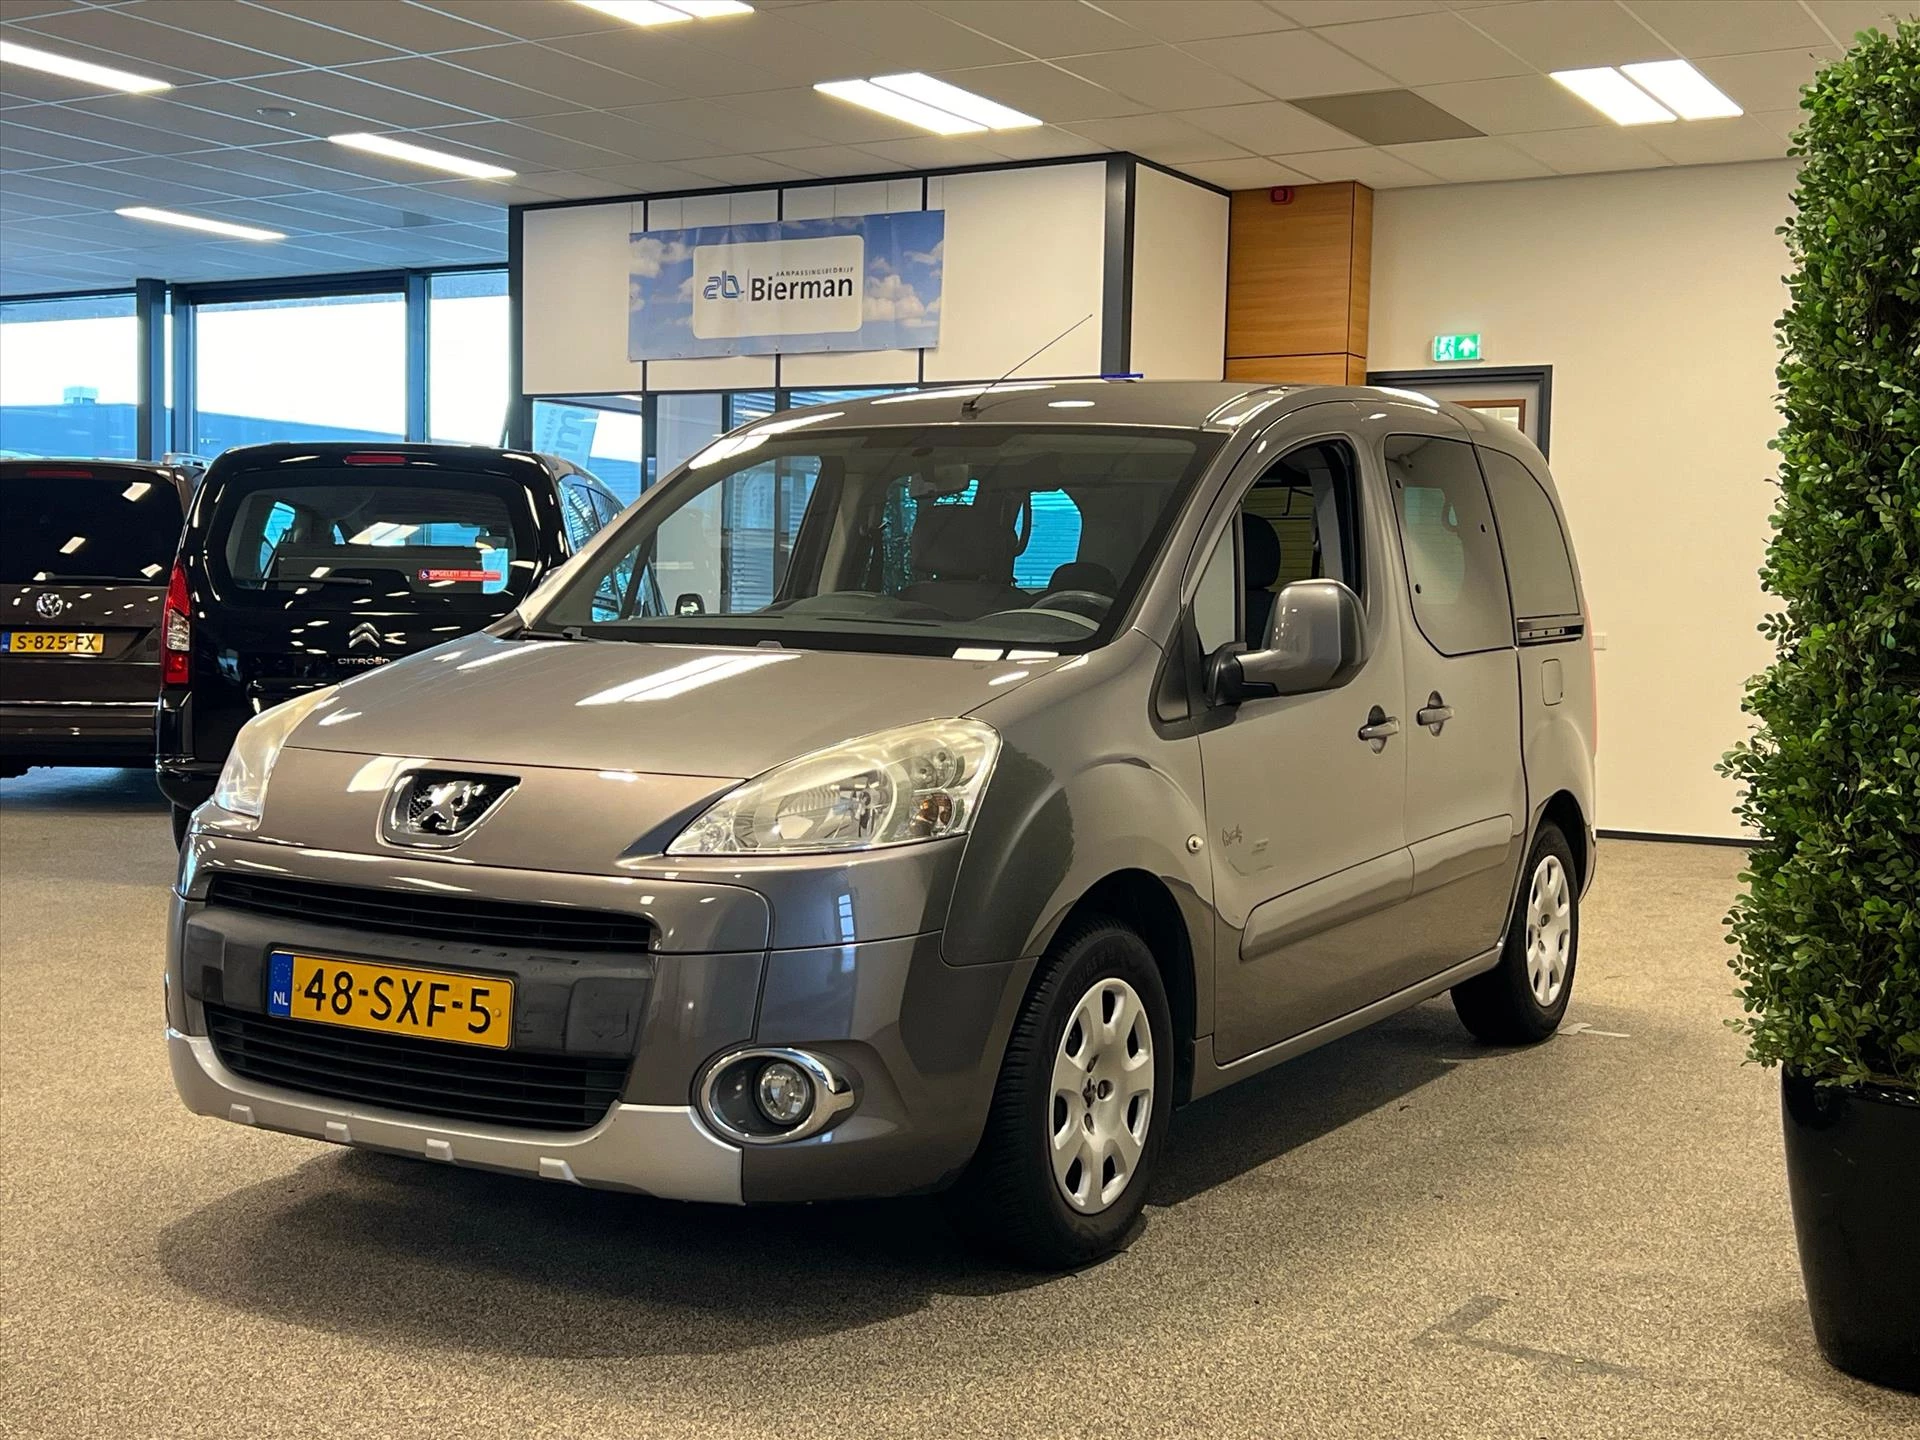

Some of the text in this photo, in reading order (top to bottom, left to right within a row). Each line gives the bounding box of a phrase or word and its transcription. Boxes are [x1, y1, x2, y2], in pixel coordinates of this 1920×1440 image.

[751, 276, 853, 302] Bierman
[16, 635, 97, 650] S-825-FX
[273, 967, 491, 1034] NL 48-SXF-5
